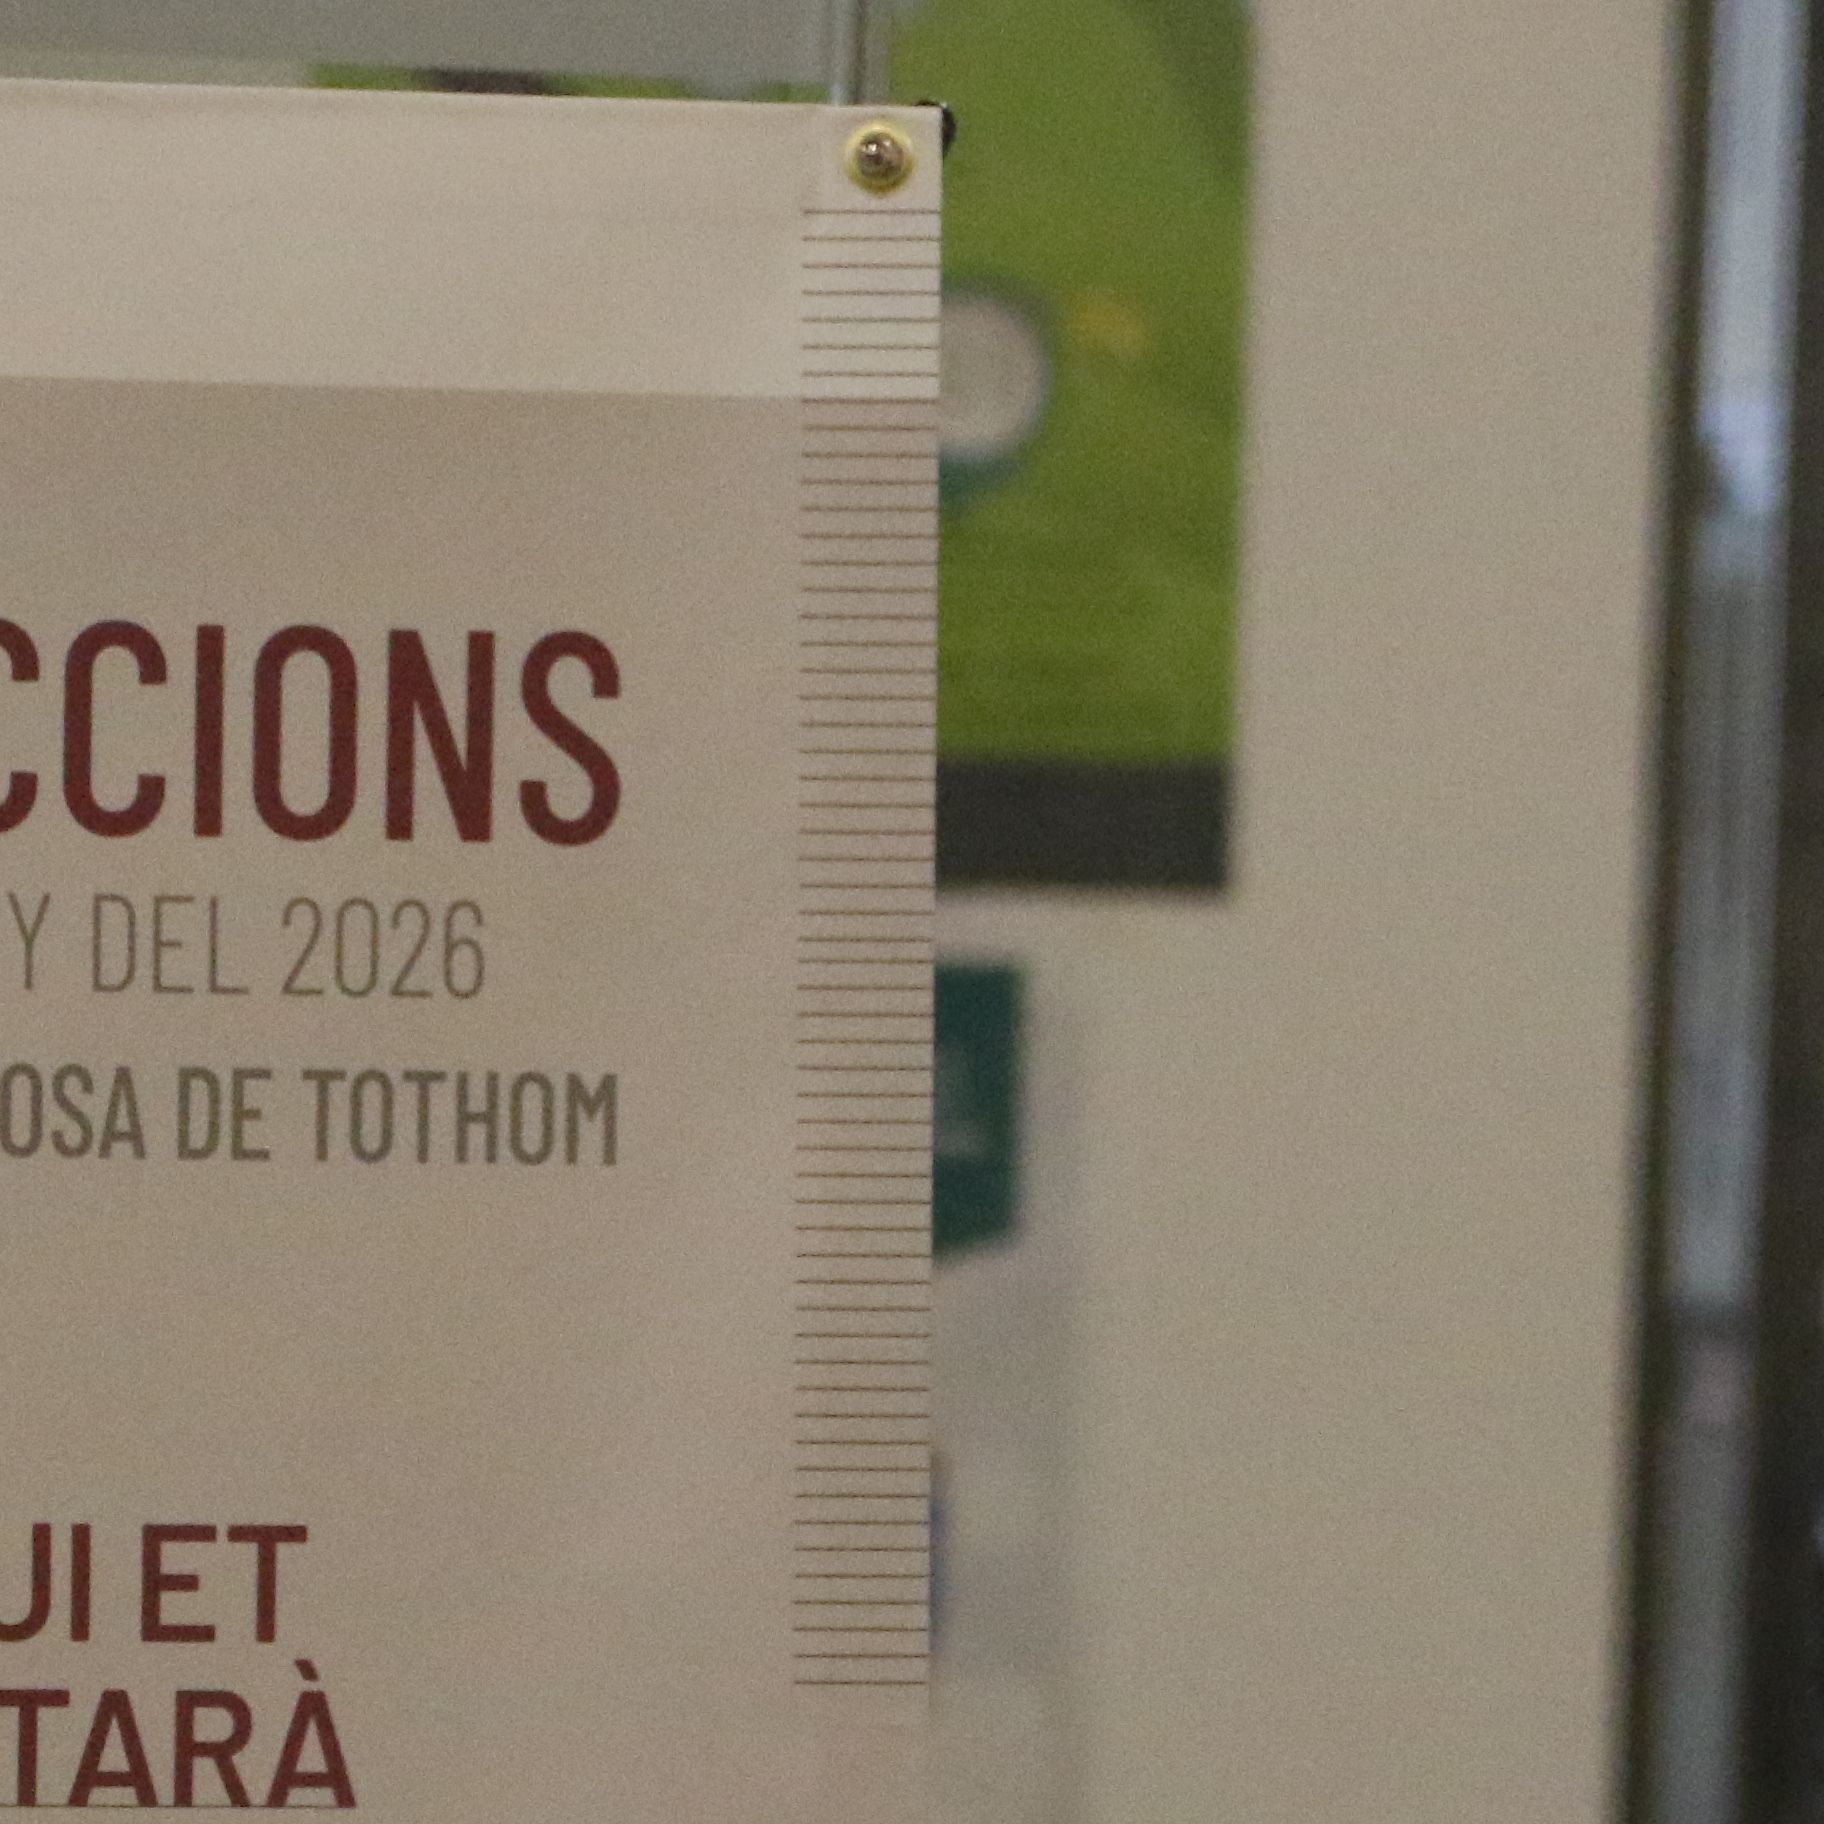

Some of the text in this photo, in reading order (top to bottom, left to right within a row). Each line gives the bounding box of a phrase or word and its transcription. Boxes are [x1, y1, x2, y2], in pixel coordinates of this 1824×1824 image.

[91, 892, 249, 996] DEL
[281, 896, 485, 1001] 2026
[177, 1066, 272, 1161] DE
[302, 1068, 617, 1165] TOTHOM
[141, 1524, 308, 1643] ET
